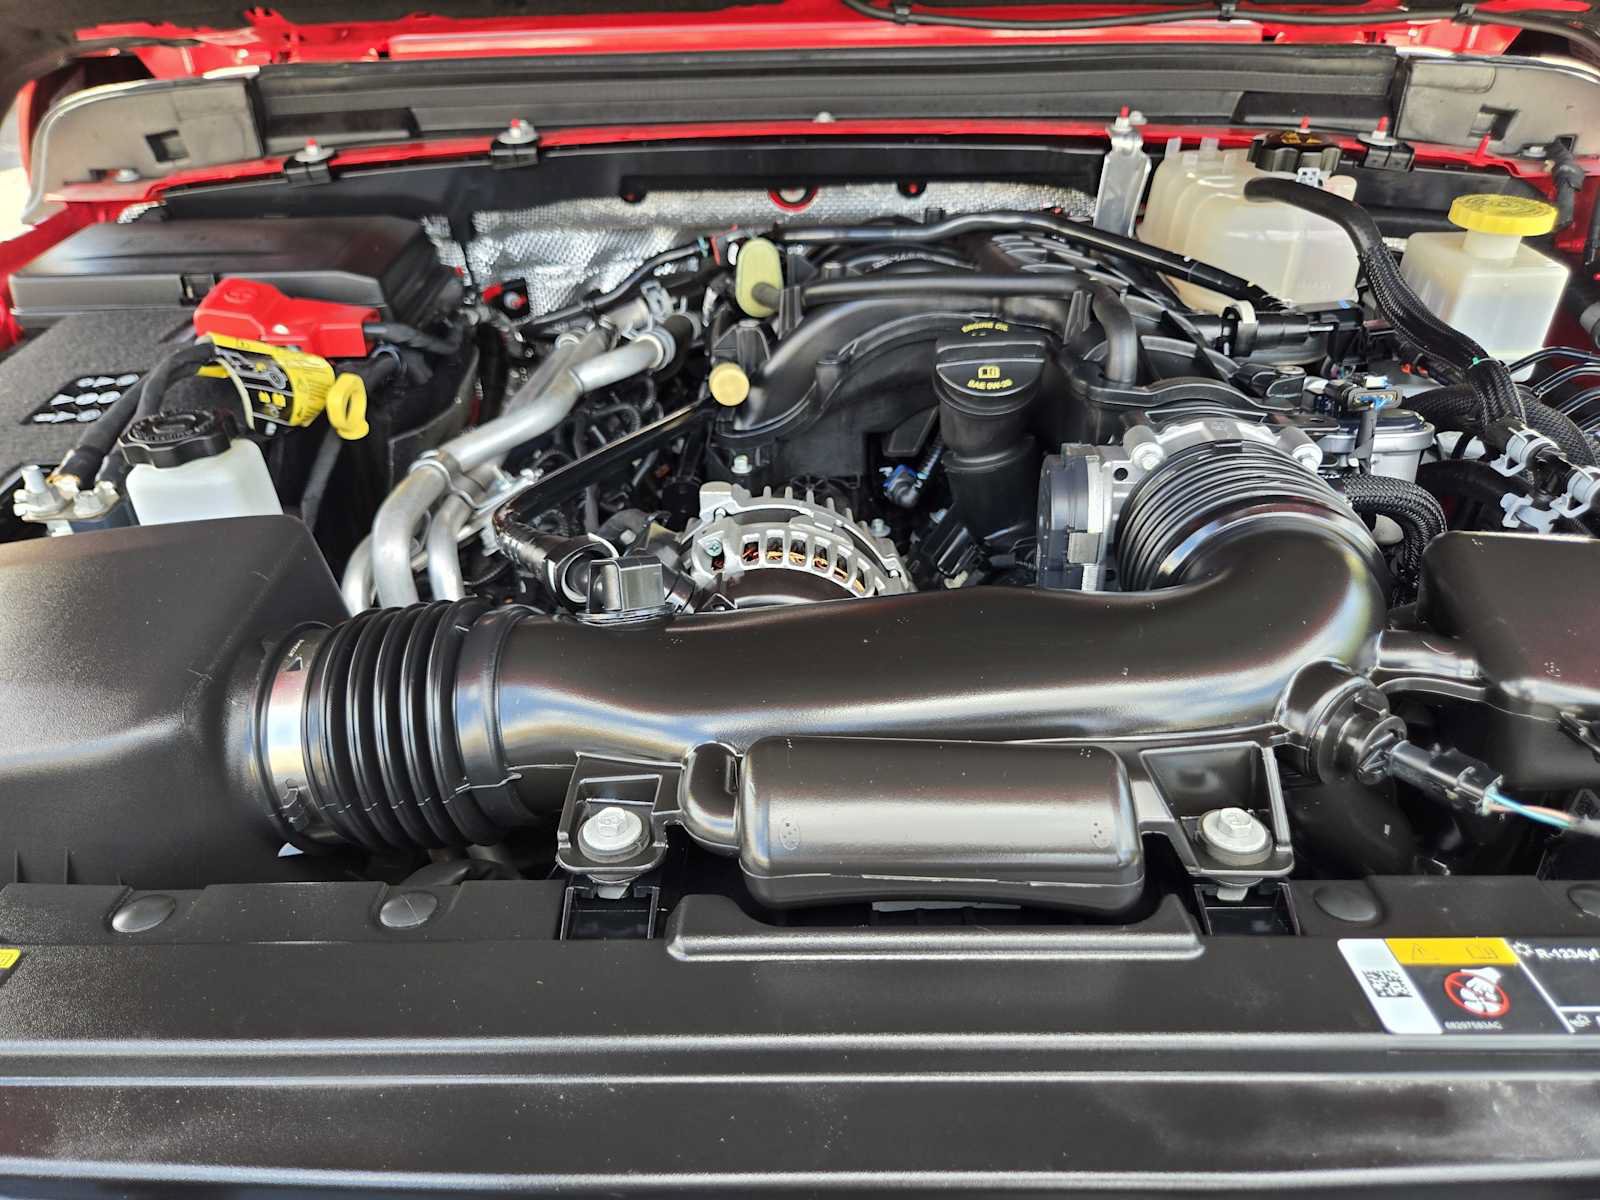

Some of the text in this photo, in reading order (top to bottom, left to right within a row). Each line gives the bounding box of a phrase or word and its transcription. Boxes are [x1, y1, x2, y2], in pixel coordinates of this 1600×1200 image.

[961, 321, 1009, 333] ENGINE OIL
[967, 379, 987, 390] SAE
